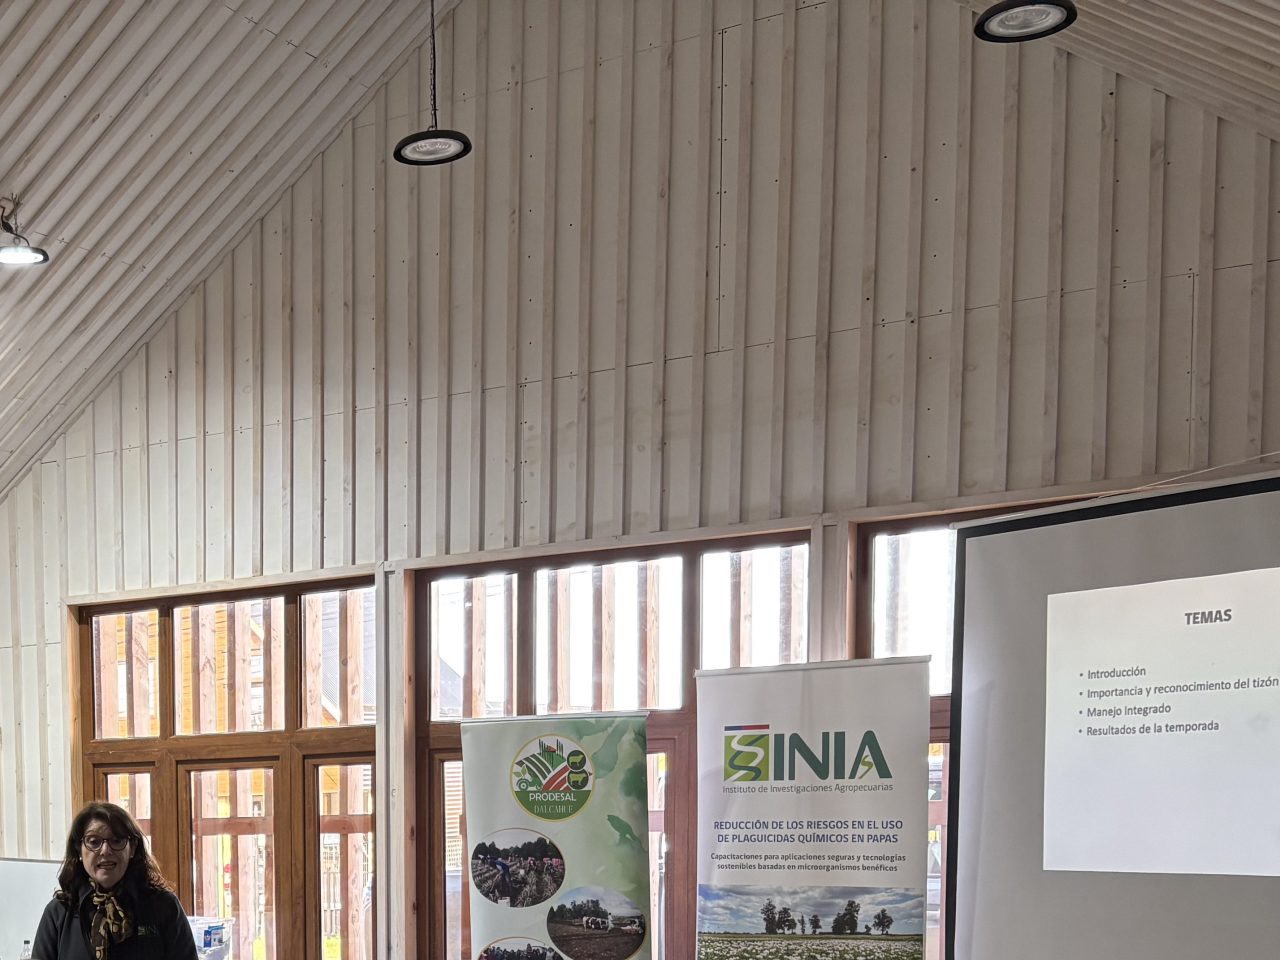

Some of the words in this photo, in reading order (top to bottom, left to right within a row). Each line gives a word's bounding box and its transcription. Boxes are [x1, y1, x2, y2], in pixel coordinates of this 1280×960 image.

[1185, 608, 1232, 625] TEMAS
[1087, 666, 1146, 680] Introducción
[1087, 686, 1143, 700] Importancia
[1145, 688, 1152, 697] y
[1154, 680, 1231, 695] reconocimiento
[1233, 678, 1250, 690] del
[1252, 676, 1279, 688] tizón
[1087, 707, 1122, 718] Manejo
[1087, 724, 1136, 736] Resultados
[1139, 723, 1151, 734] de
[1154, 722, 1162, 733] la
[1165, 720, 1220, 734] temporada
[773, 730, 893, 781] INIA
[723, 785, 756, 793] Instituto
[758, 785, 768, 793] de
[770, 784, 833, 794] Investigaciones
[834, 783, 894, 793] Agropecuarias
[529, 792, 576, 801] PRODESAL
[713, 819, 769, 830] REDUCCIÓN
[771, 820, 784, 829] DE
[786, 820, 804, 829] LOS
[806, 820, 849, 829] RIESGOS
[851, 820, 865, 829] EN
[867, 820, 878, 829] EL
[881, 820, 903, 829] USO
[717, 834, 730, 843] DE
[732, 834, 795, 843] PLAGUICIDAS
[797, 832, 849, 844] QUÍMICOS
[851, 834, 864, 843] EN
[867, 833, 898, 843] PAPAS
[710, 852, 762, 861] Capacitaciones
[780, 853, 826, 862] aplicaciones
[827, 854, 855, 862] seguras
[862, 853, 906, 863] tecnologías
[717, 862, 756, 870] sostenibles
[757, 862, 786, 870] basadas
[797, 863, 860, 872] microorganismos
[862, 863, 898, 872] benéficos
